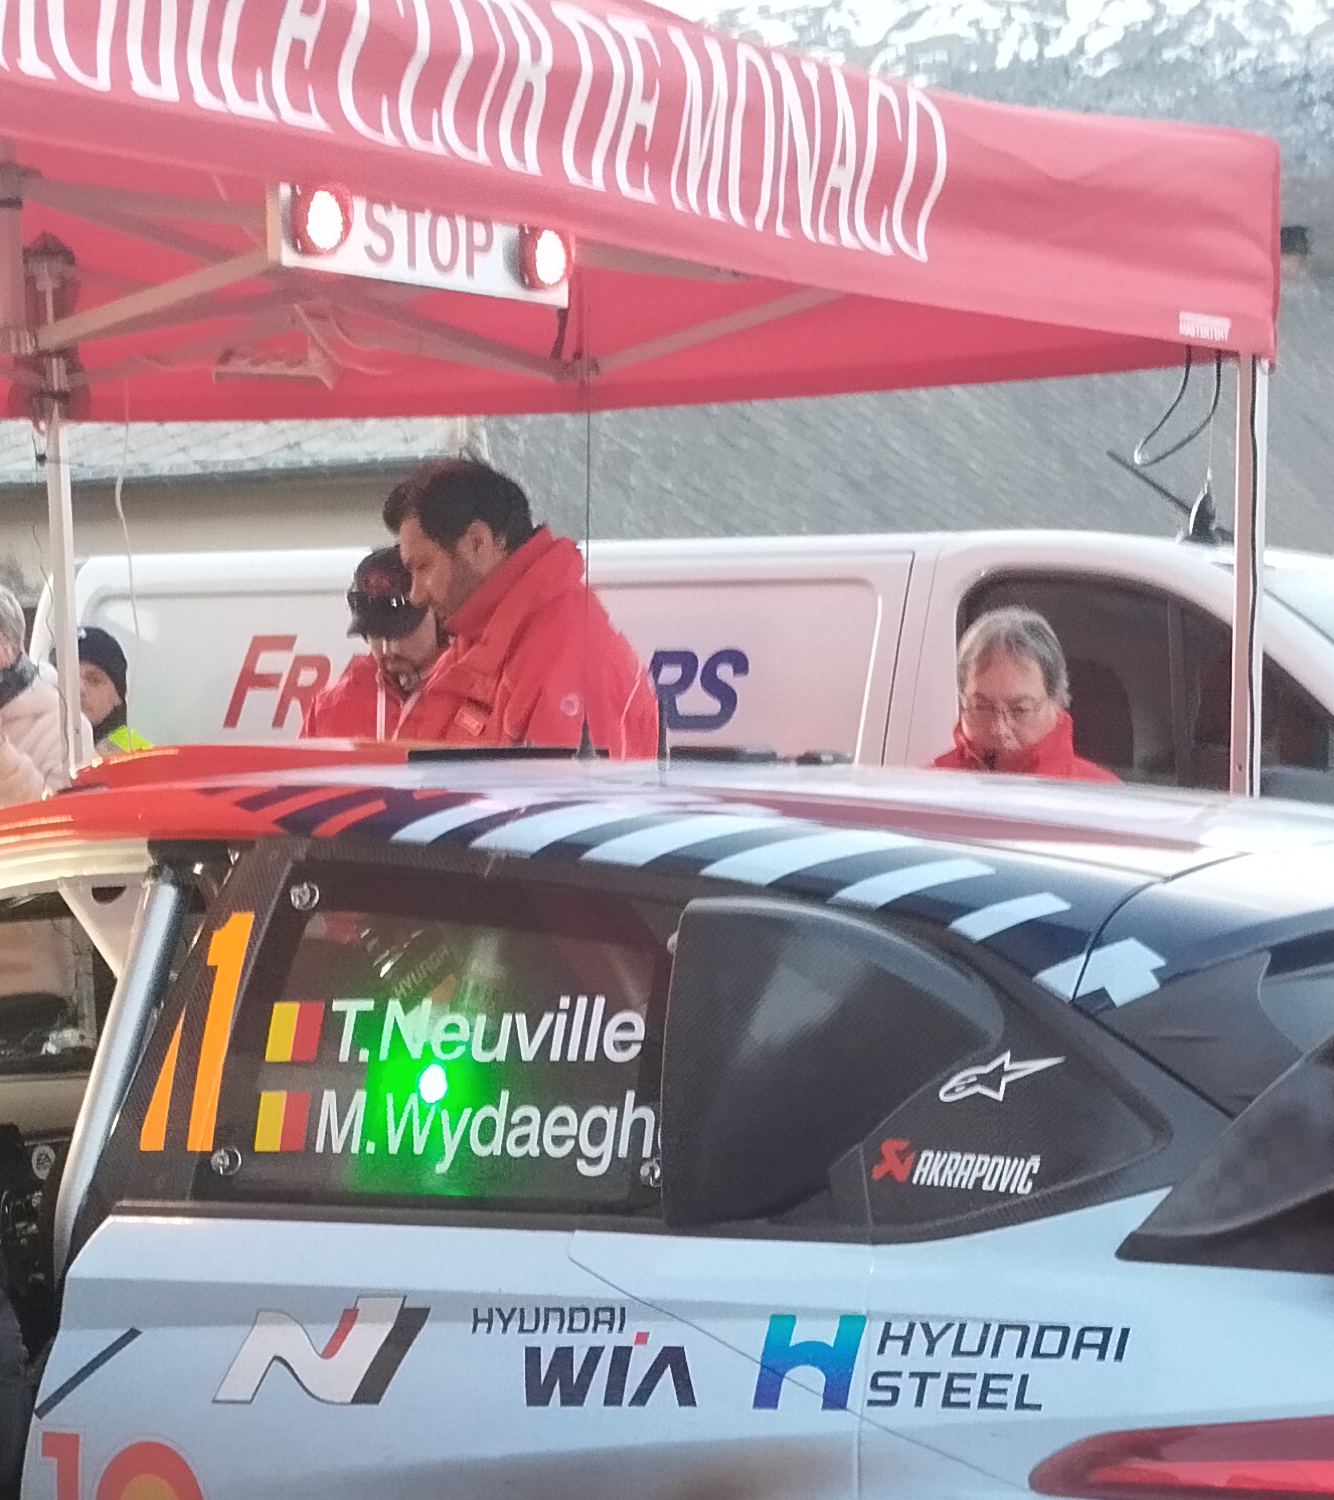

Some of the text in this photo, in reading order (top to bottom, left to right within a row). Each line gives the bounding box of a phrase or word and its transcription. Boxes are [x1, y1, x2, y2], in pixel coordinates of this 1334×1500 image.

[337, 0, 555, 176] CLUB
[551, 1, 661, 205] DE
[668, 25, 947, 263] MONACO
[363, 200, 496, 280] STOP
[330, 995, 647, 1064] T.Neuville
[316, 1089, 659, 1178] M.Wydaegh
[471, 1306, 626, 1335] HYUNDAI
[876, 1320, 1131, 1363] HYUNDAI
[524, 1331, 697, 1408] WIA
[866, 1371, 1043, 1412] STEEL
